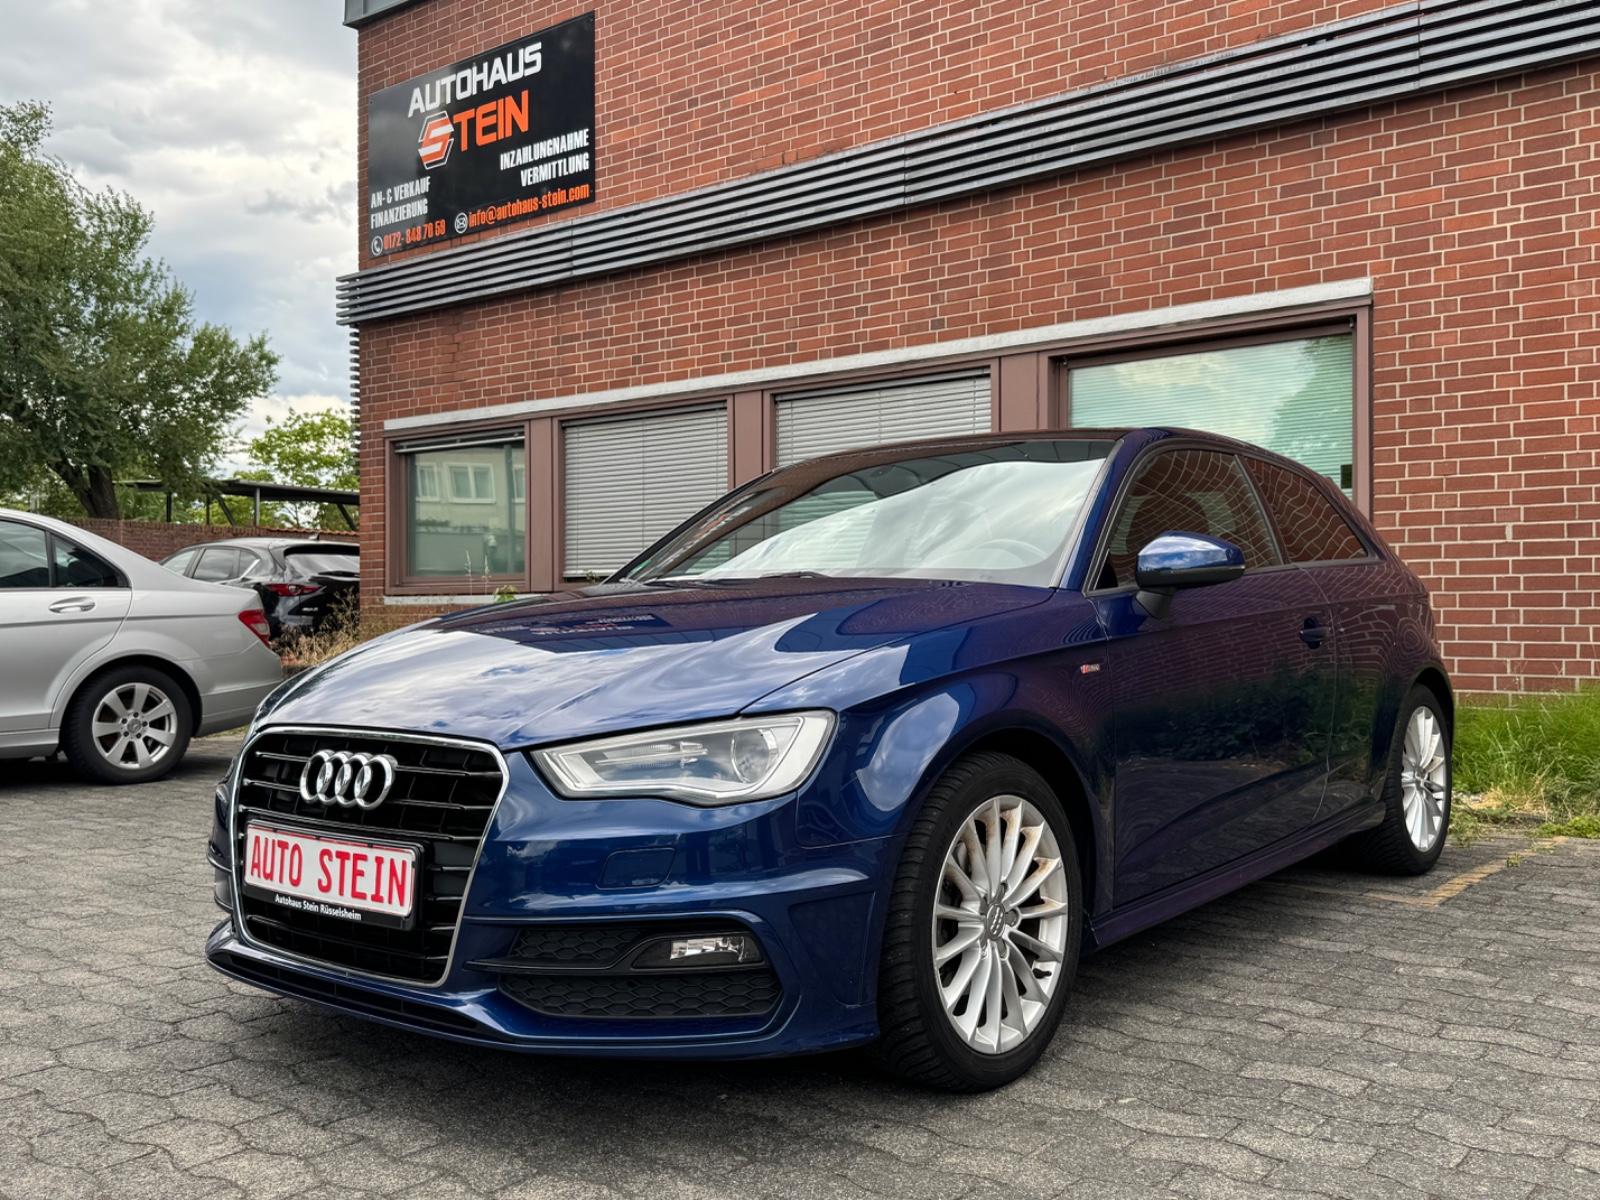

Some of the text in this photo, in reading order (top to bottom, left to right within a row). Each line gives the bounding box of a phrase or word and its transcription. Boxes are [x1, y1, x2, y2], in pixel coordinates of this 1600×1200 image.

[408, 42, 542, 117] AUTOHAUS
[418, 90, 529, 169] STEIN
[500, 128, 589, 170] INZAHLUNGNAHME
[394, 176, 431, 201] VERKAUF
[521, 153, 590, 187] VERMITTLUNG
[371, 198, 428, 229] FINANZIERUNG
[469, 184, 590, 227] info@autohaus-stein.com
[406, 225, 421, 244] 848
[422, 222, 433, 239] 70
[251, 835, 407, 907] AUTO STEIN
[275, 894, 361, 921] Autohaus Stein Rüsselsheim
